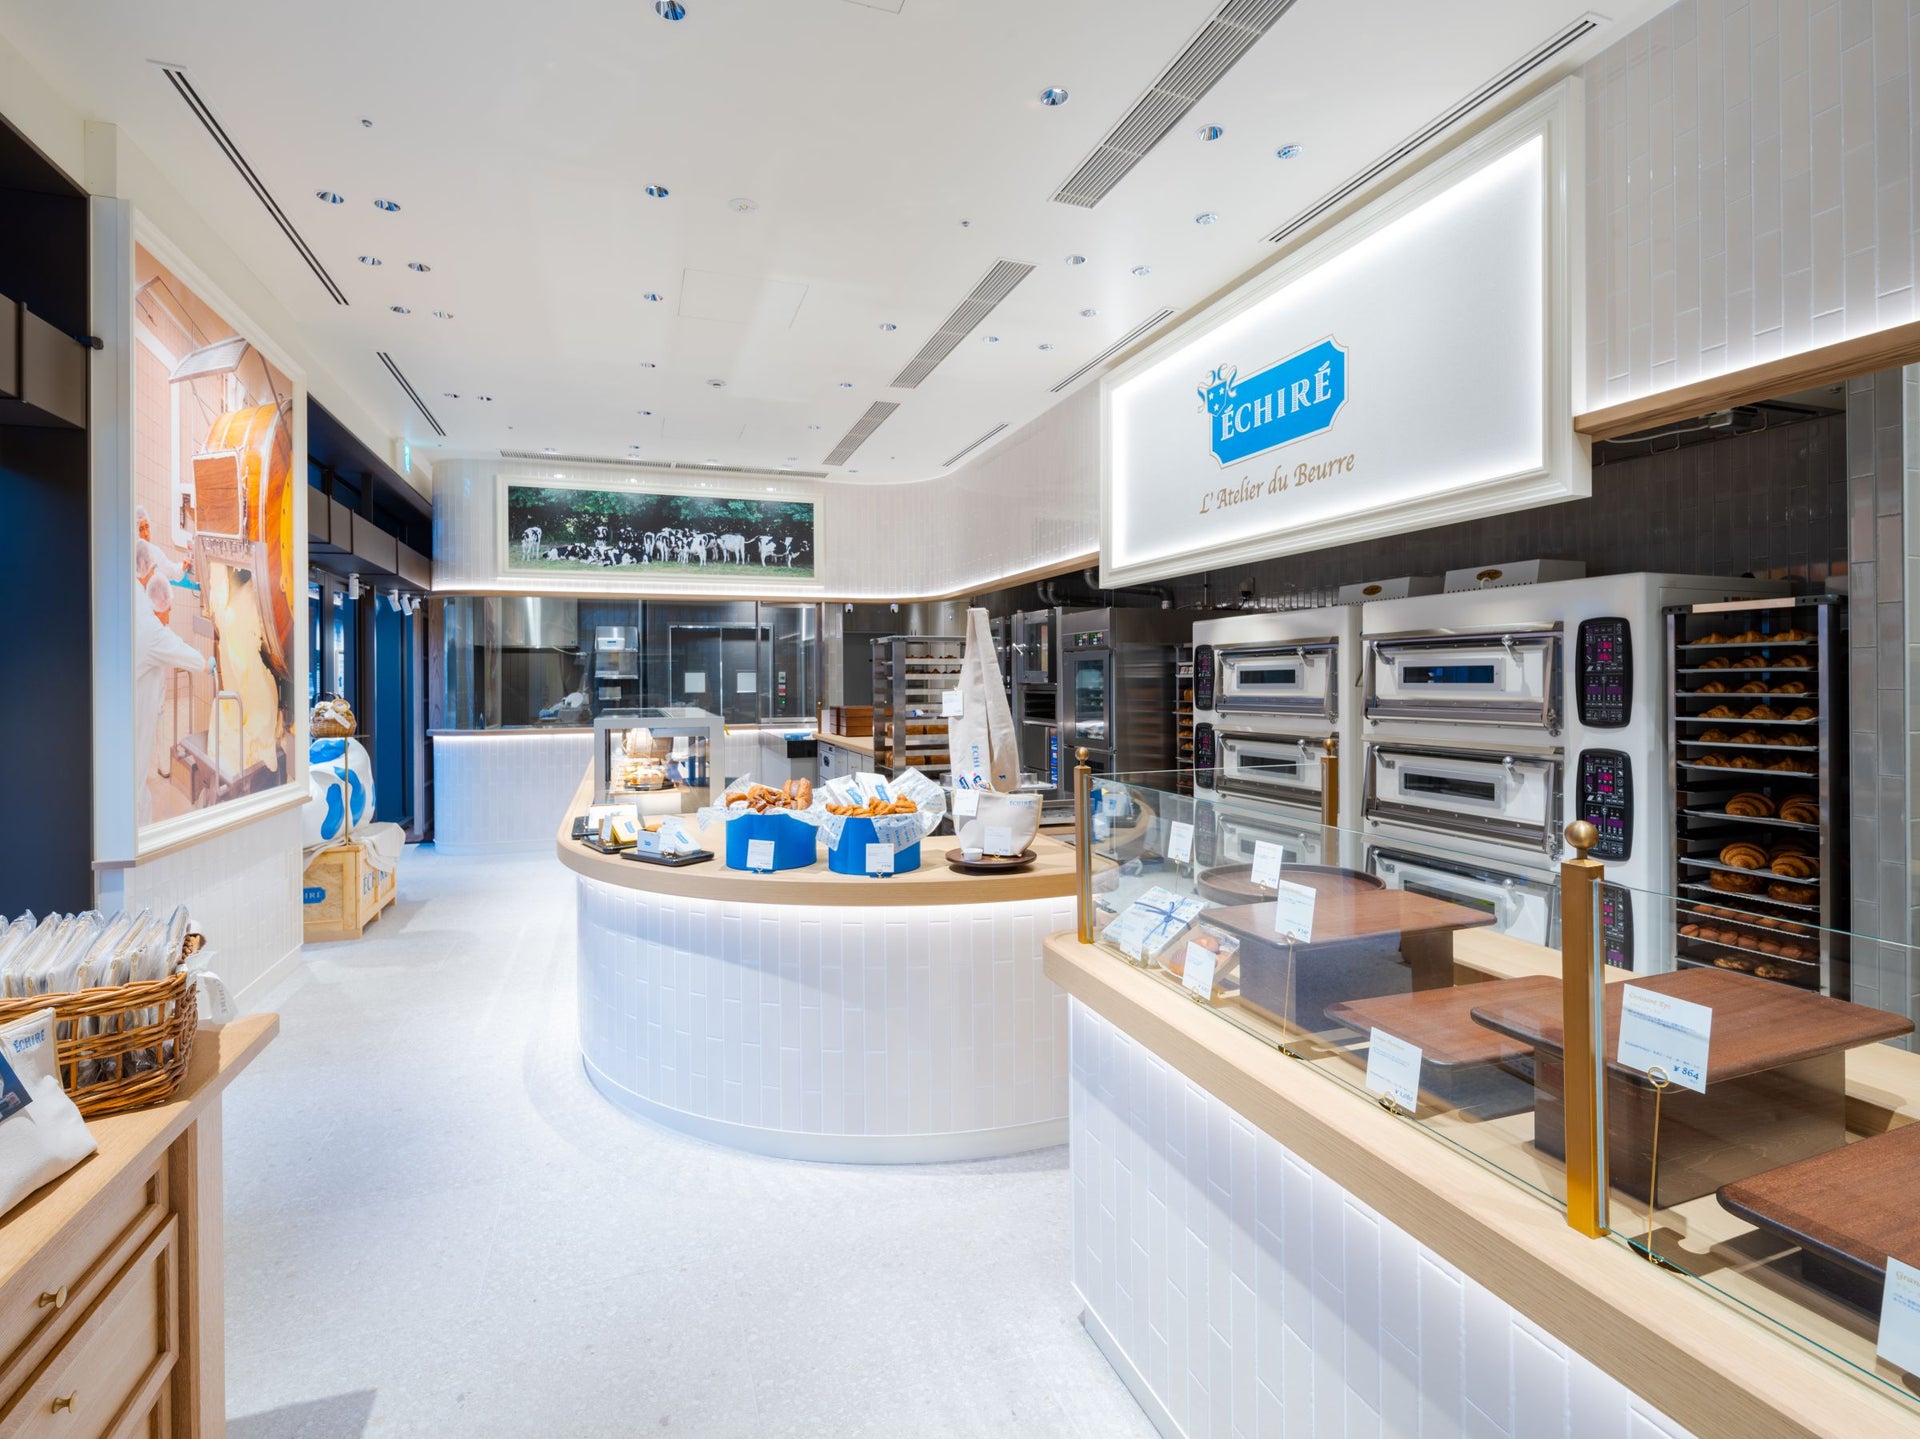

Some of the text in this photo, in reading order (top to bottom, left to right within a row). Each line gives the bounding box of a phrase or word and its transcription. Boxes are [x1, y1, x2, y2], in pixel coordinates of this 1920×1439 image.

[1221, 360, 1332, 441] ÉCHIRÉ
[1268, 465, 1289, 495] du
[1294, 453, 1355, 487] Beurre
[1681, 1067, 1699, 1080] 864
